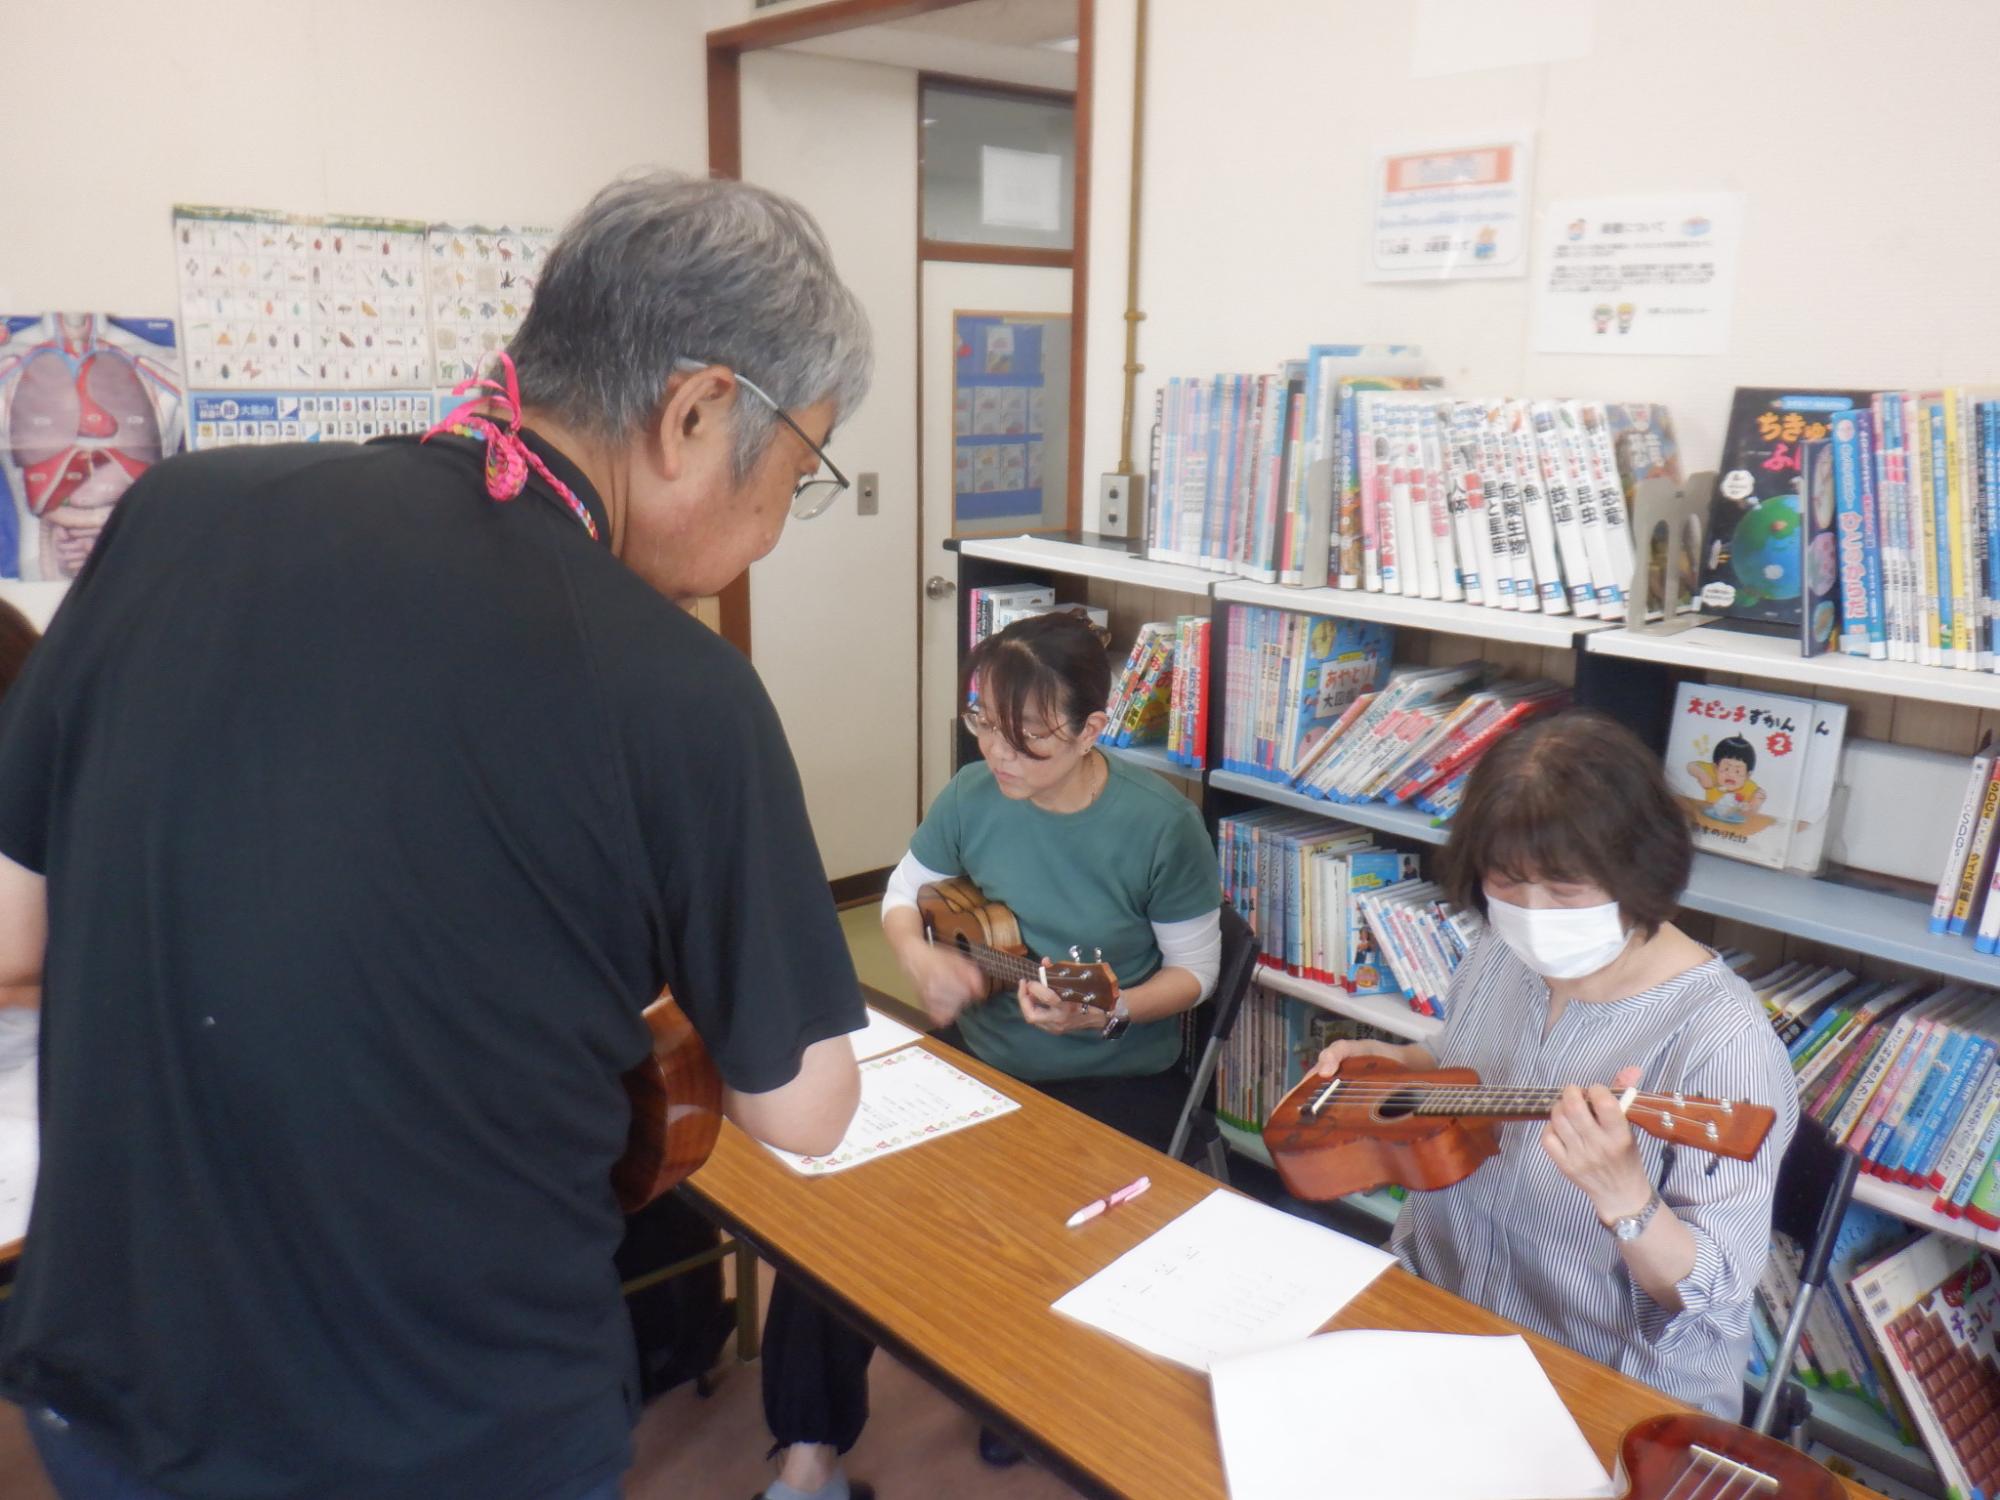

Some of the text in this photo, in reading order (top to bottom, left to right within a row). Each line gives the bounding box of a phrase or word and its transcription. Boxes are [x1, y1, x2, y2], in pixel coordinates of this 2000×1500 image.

[1550, 485, 1574, 523] 鉄道
[1576, 484, 1600, 525] 昆虫
[1687, 698, 1796, 732] 大ピンチずかん
